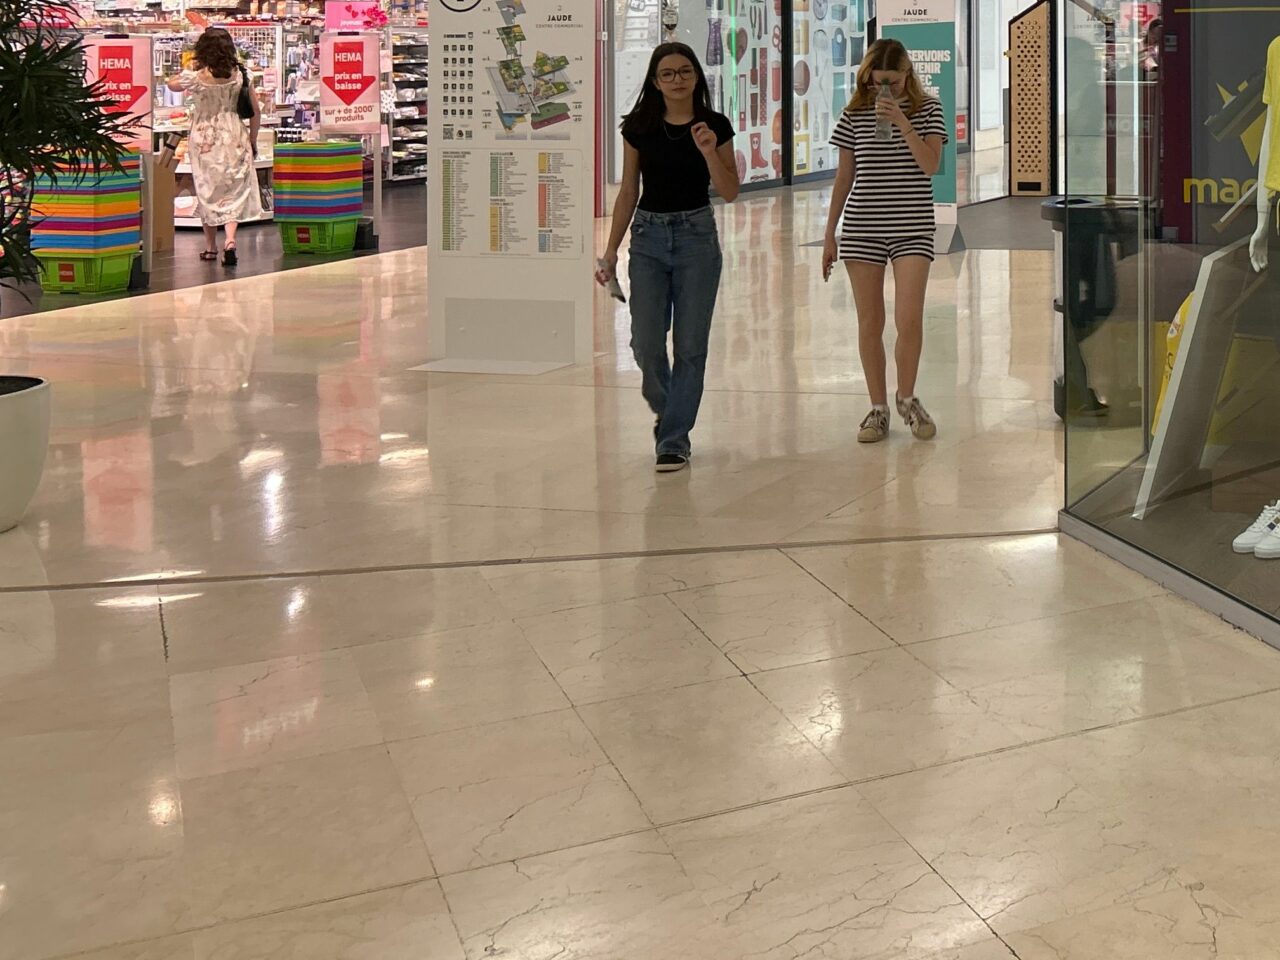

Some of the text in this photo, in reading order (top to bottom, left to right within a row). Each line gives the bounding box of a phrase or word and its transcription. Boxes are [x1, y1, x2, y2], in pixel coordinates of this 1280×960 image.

[547, 14, 573, 22] JAUDE
[334, 52, 362, 62] HEMA
[906, 49, 951, 62] SERVONS
[100, 58, 132, 69] HEMA
[335, 71, 350, 81] prix
[119, 82, 132, 90] en
[334, 81, 362, 90] baisse
[343, 105, 352, 113] de
[335, 114, 364, 123] produits
